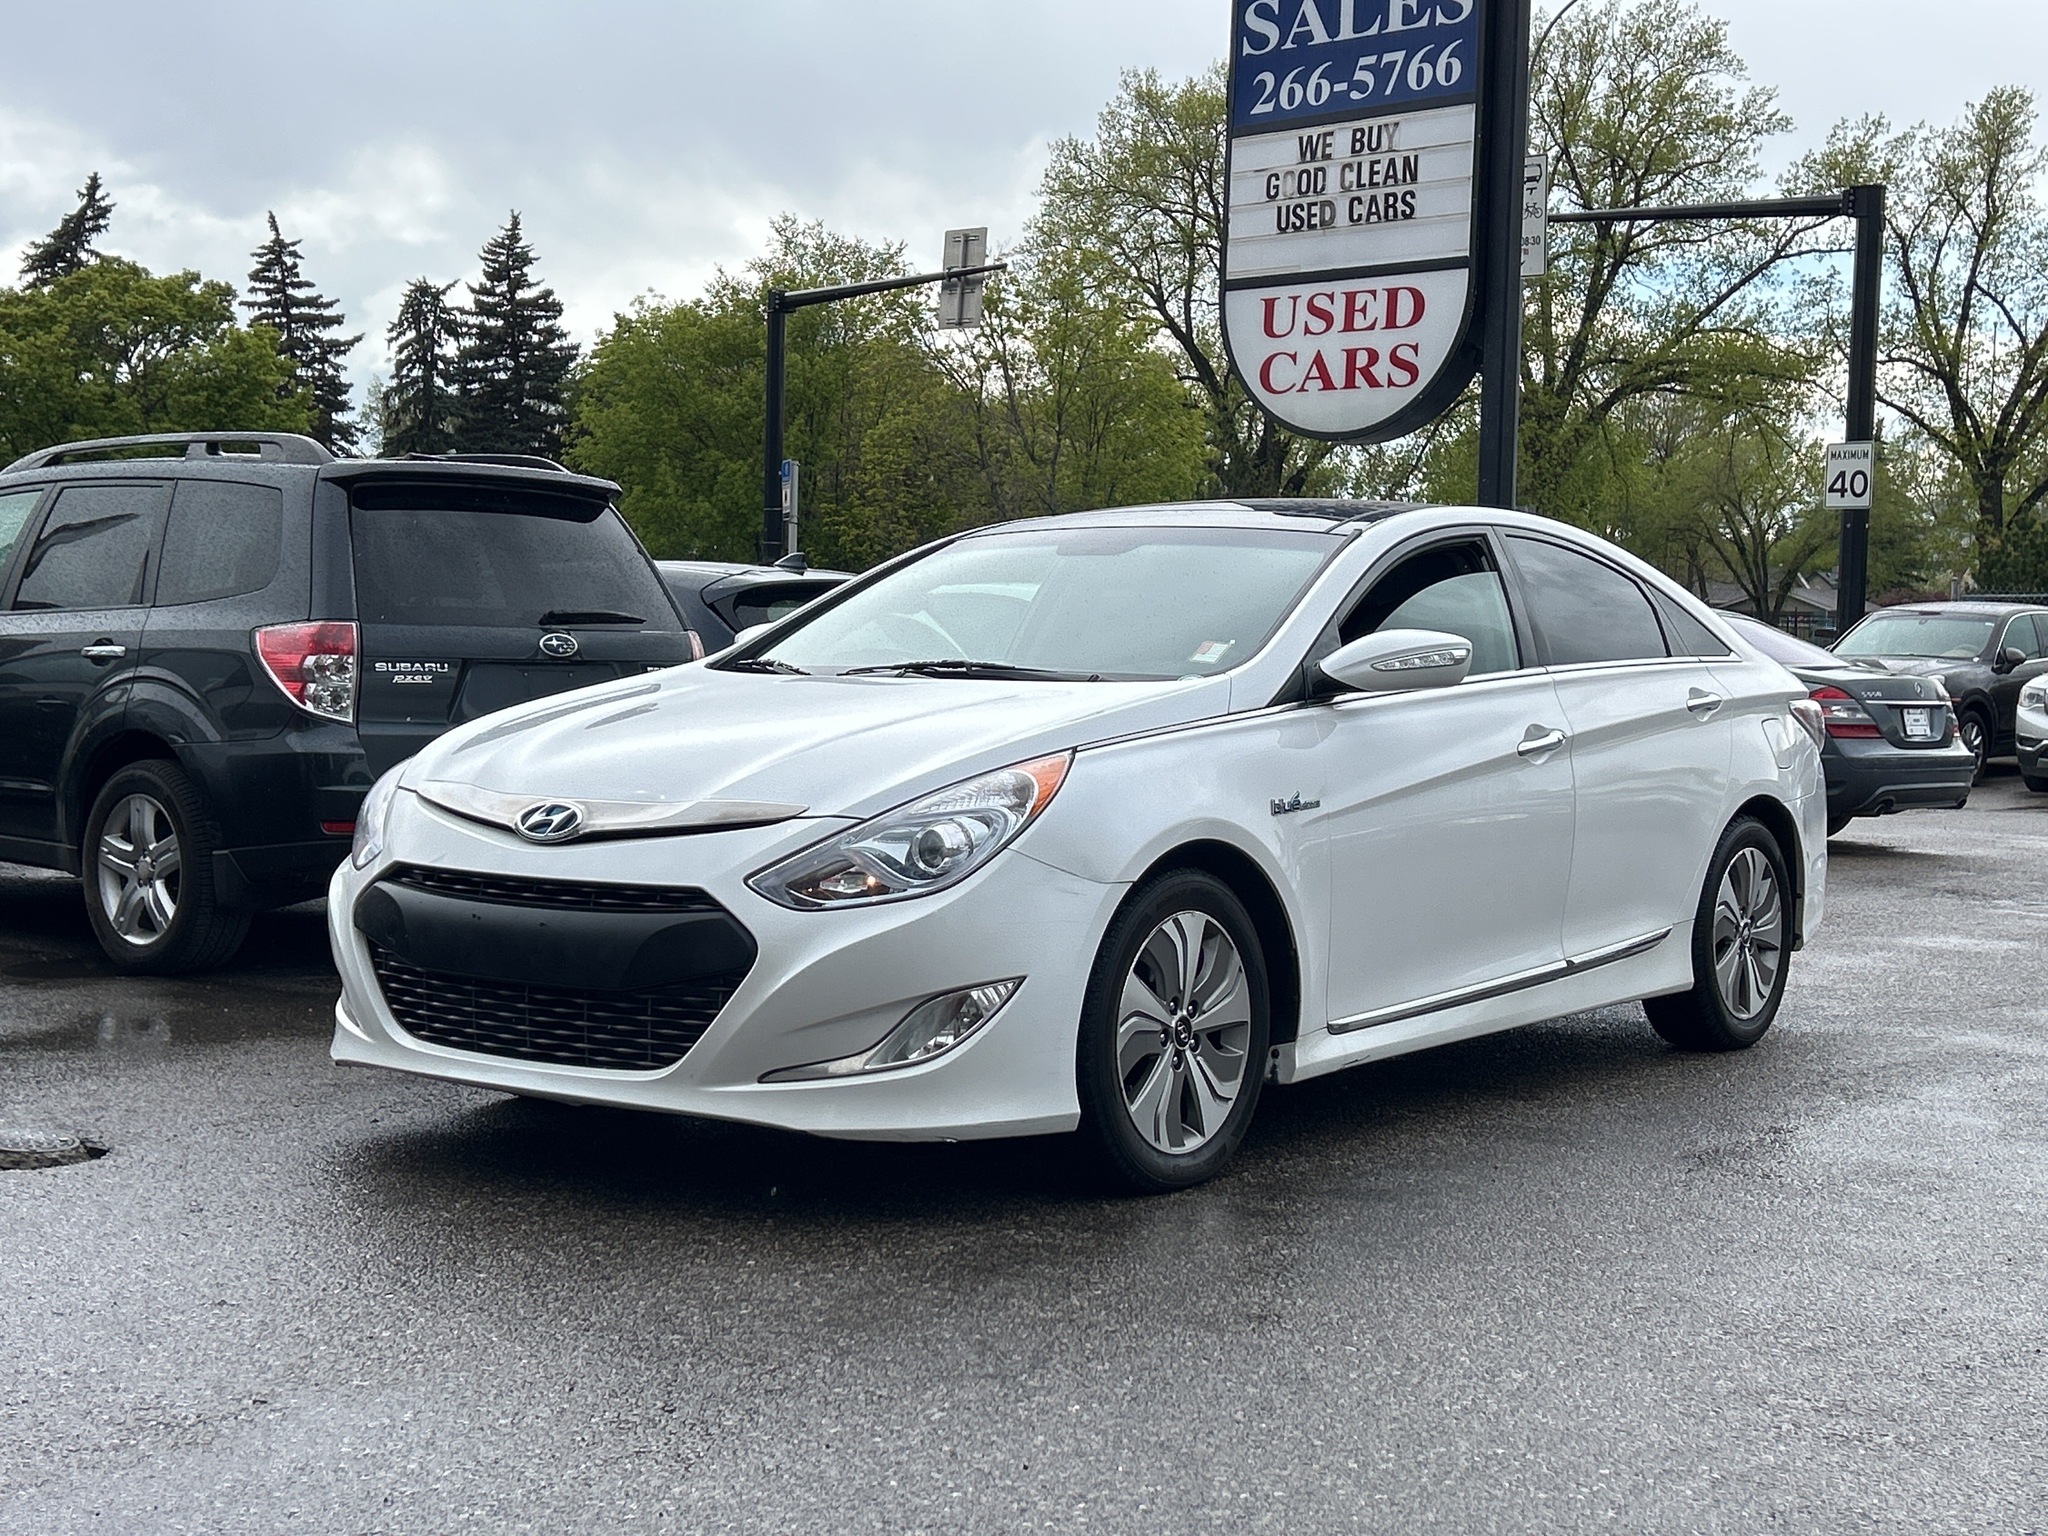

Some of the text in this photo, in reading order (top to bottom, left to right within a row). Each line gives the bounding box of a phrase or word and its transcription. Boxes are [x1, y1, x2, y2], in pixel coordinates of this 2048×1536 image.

[1250, 38, 1463, 115] 266-5766
[1299, 122, 1400, 161] WE BUY
[1266, 155, 1418, 200] GOOD CLEAN
[1276, 190, 1416, 233] USED CARS
[1260, 286, 1426, 339] USED
[1259, 342, 1420, 395] CARS
[1830, 449, 1869, 460] MAXIMUM
[1828, 469, 1869, 498] 40
[374, 662, 449, 672] SUBARU
